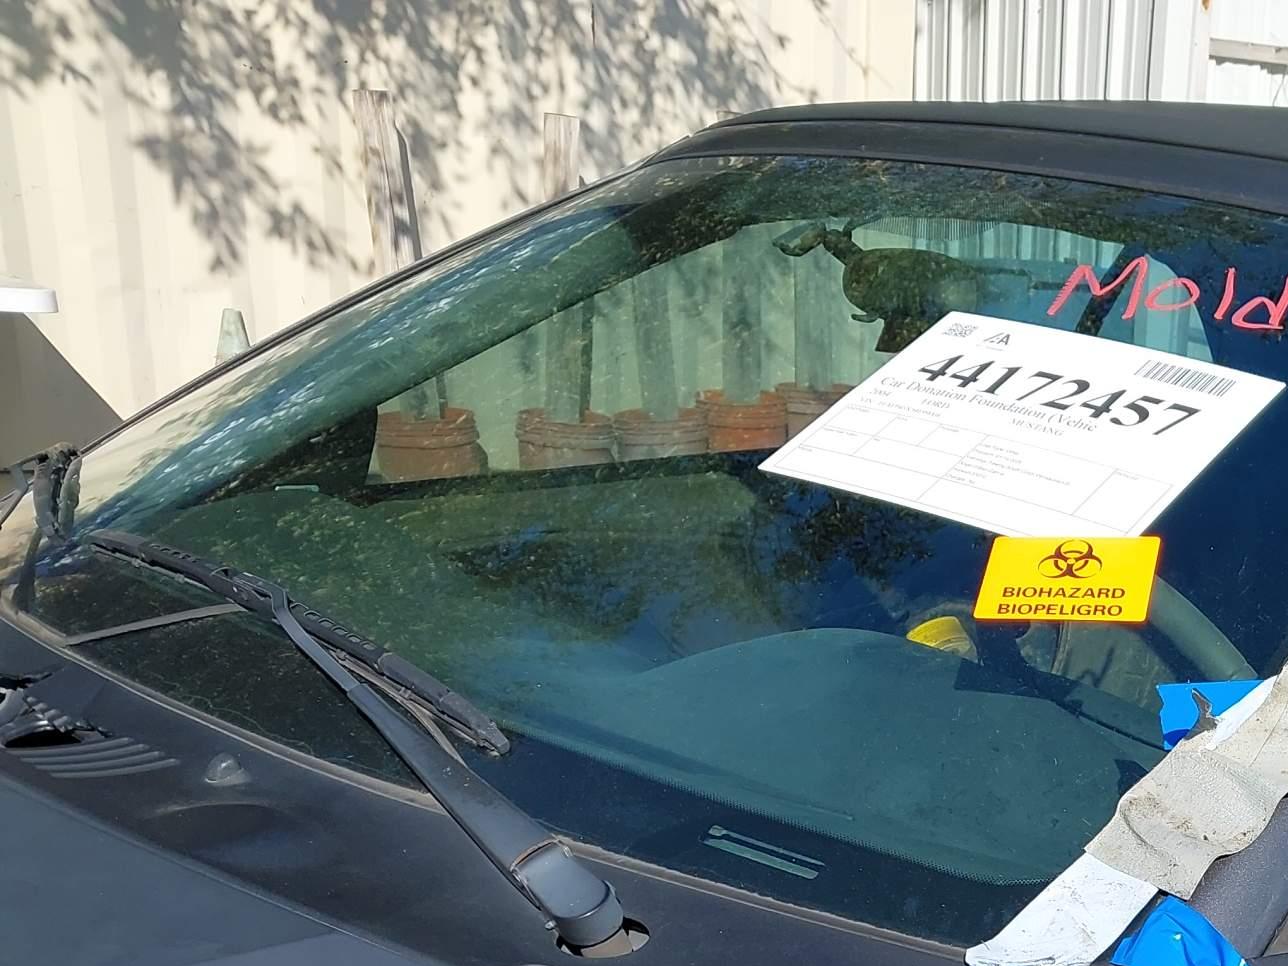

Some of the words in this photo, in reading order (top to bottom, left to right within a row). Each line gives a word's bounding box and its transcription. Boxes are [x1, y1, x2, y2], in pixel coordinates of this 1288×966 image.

[881, 377, 906, 388] Car
[906, 381, 967, 401] Donation
[969, 394, 1046, 419] Foundation
[918, 354, 1202, 436] 44172457
[1002, 586, 1125, 601] BIOHAZARD
[996, 604, 1123, 617] BIOPELIGRO
